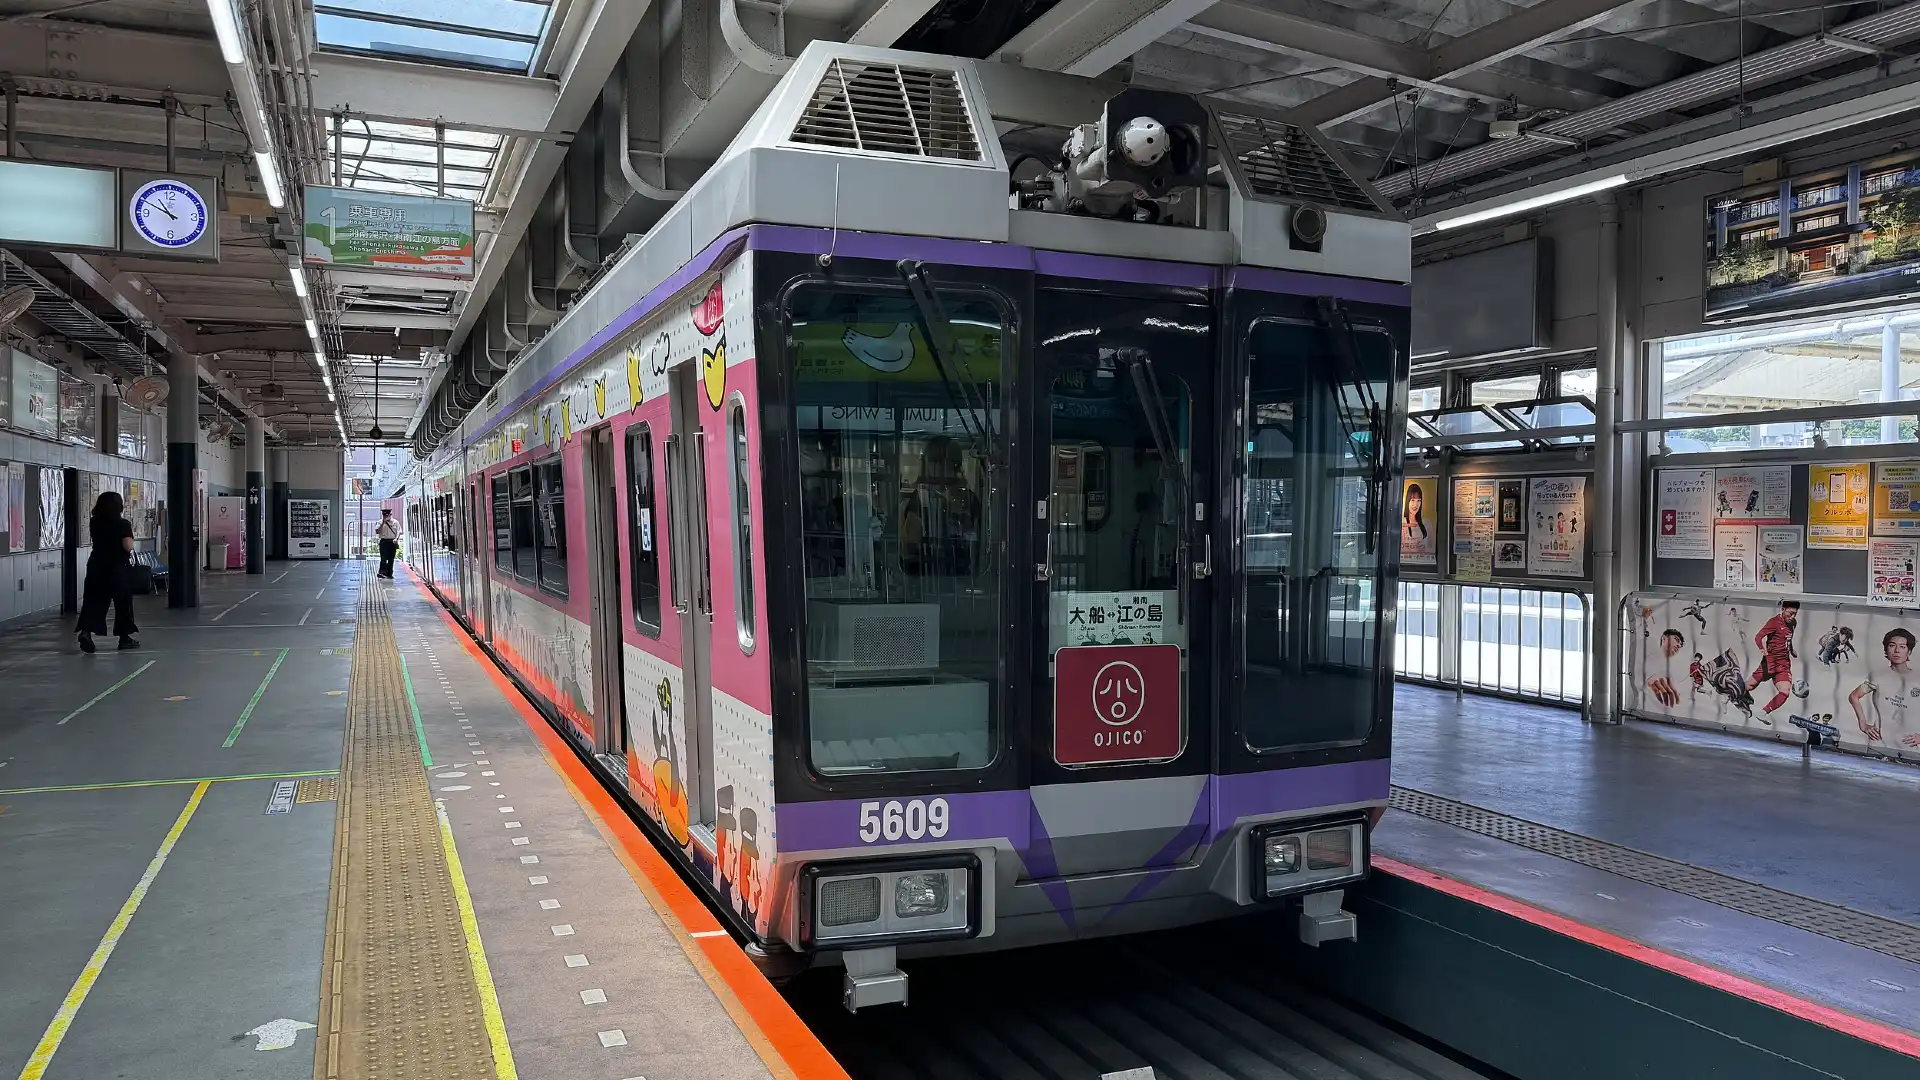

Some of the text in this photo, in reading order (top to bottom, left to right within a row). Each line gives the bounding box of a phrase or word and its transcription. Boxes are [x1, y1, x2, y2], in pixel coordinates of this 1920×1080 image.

[164, 191, 176, 201] 12
[143, 208, 150, 218] 9
[190, 212, 198, 222] 3
[349, 204, 407, 222] 乗車専用
[167, 230, 174, 239] 6
[320, 206, 337, 246] 1
[349, 228, 460, 247] 湘南深沢・湘南江の島方面
[1132, 596, 1148, 605] 湘南
[1069, 604, 1163, 625] 大船 江の島
[1094, 730, 1143, 747] OJICO
[859, 797, 949, 843] 5609
